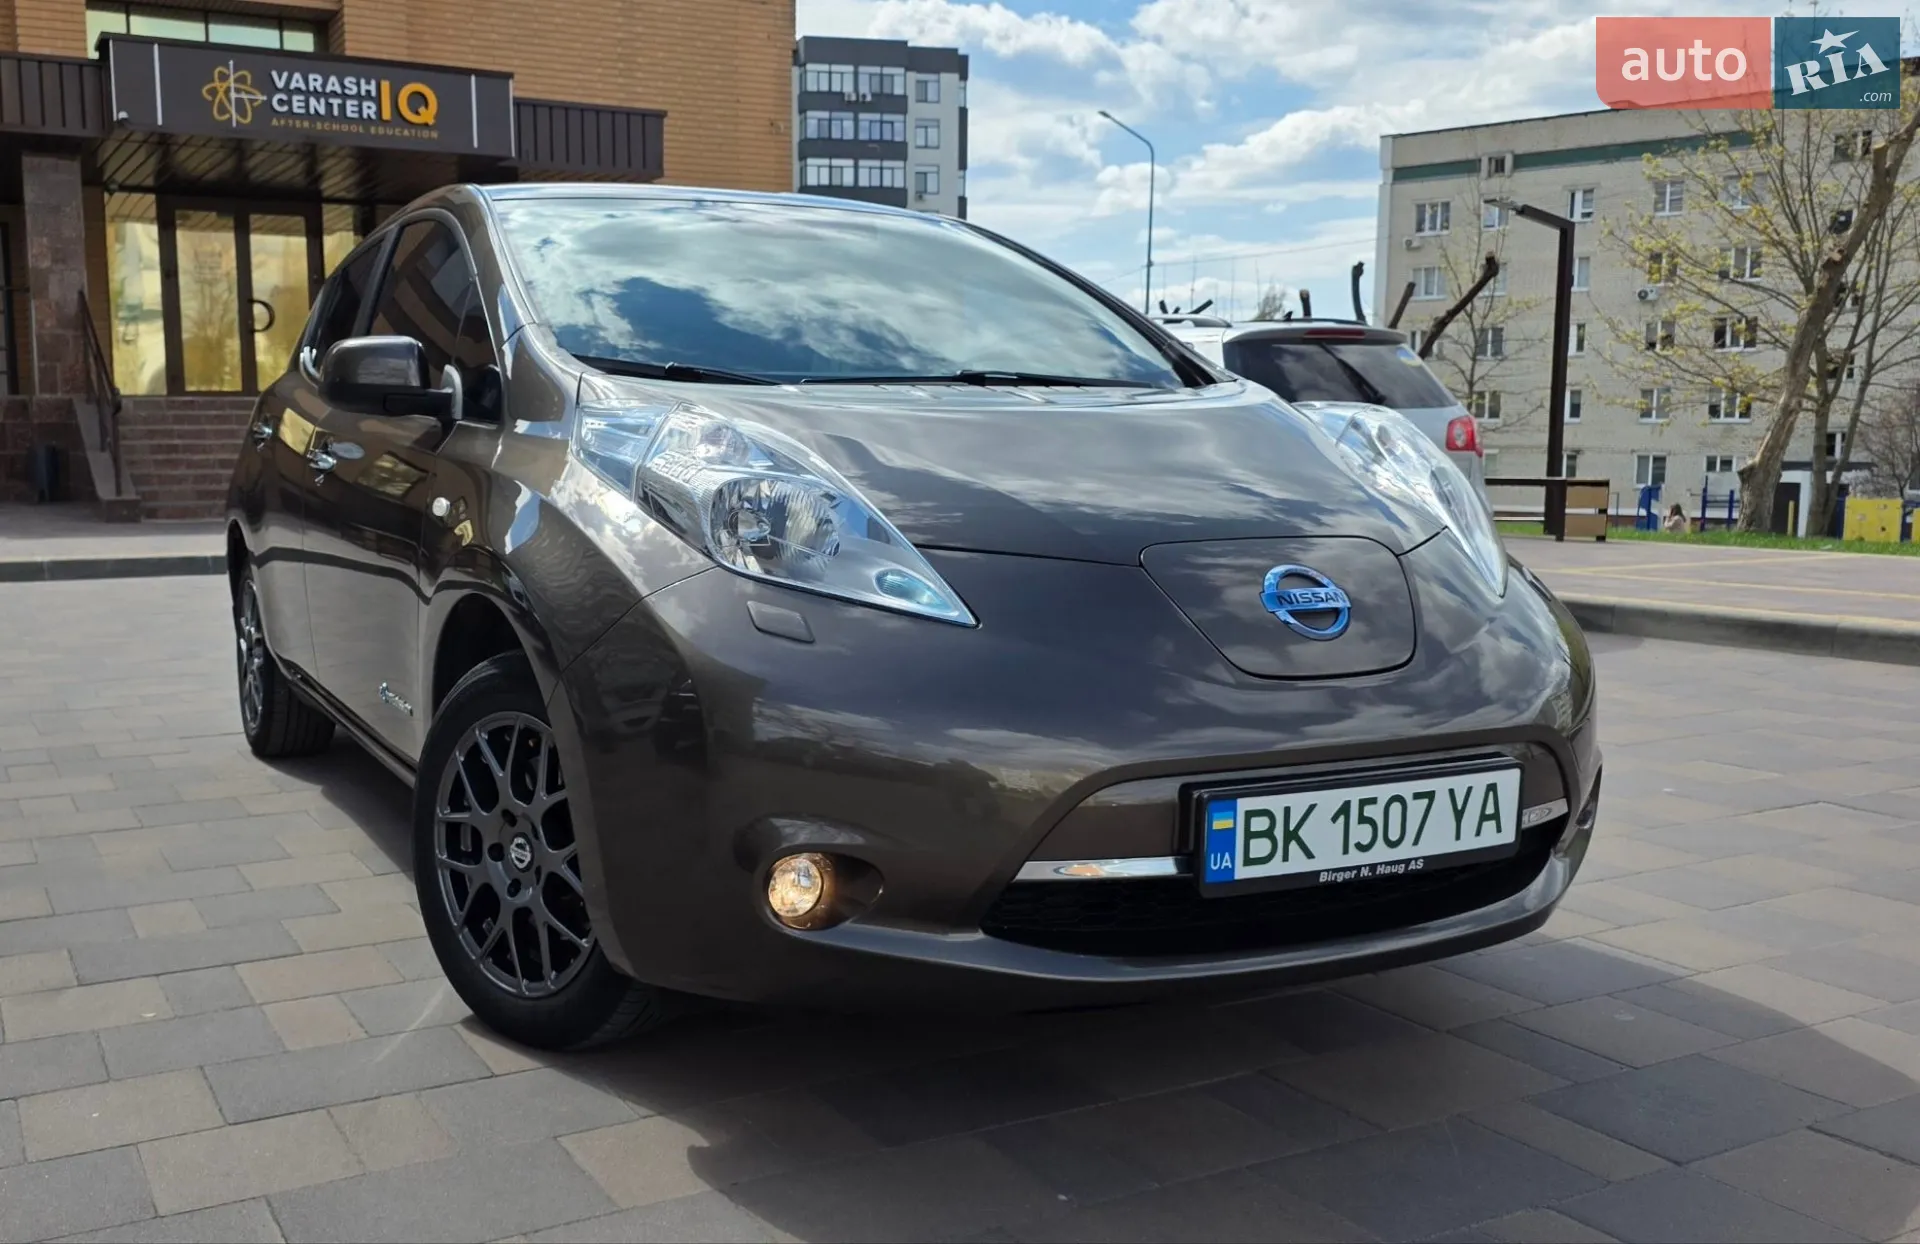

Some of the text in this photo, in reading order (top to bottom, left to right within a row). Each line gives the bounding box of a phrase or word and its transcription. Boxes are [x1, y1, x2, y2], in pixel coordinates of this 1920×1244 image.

[271, 69, 376, 97] VARASH
[271, 93, 376, 120] CENTER
[380, 80, 438, 126] IQ
[271, 117, 439, 139] AFTER-SCHOOL EDUCATION
[1277, 591, 1347, 606] NISSAN
[1210, 782, 1503, 870] UA BK 1507 YA
[1319, 858, 1424, 882] Birger N. Haug AS
